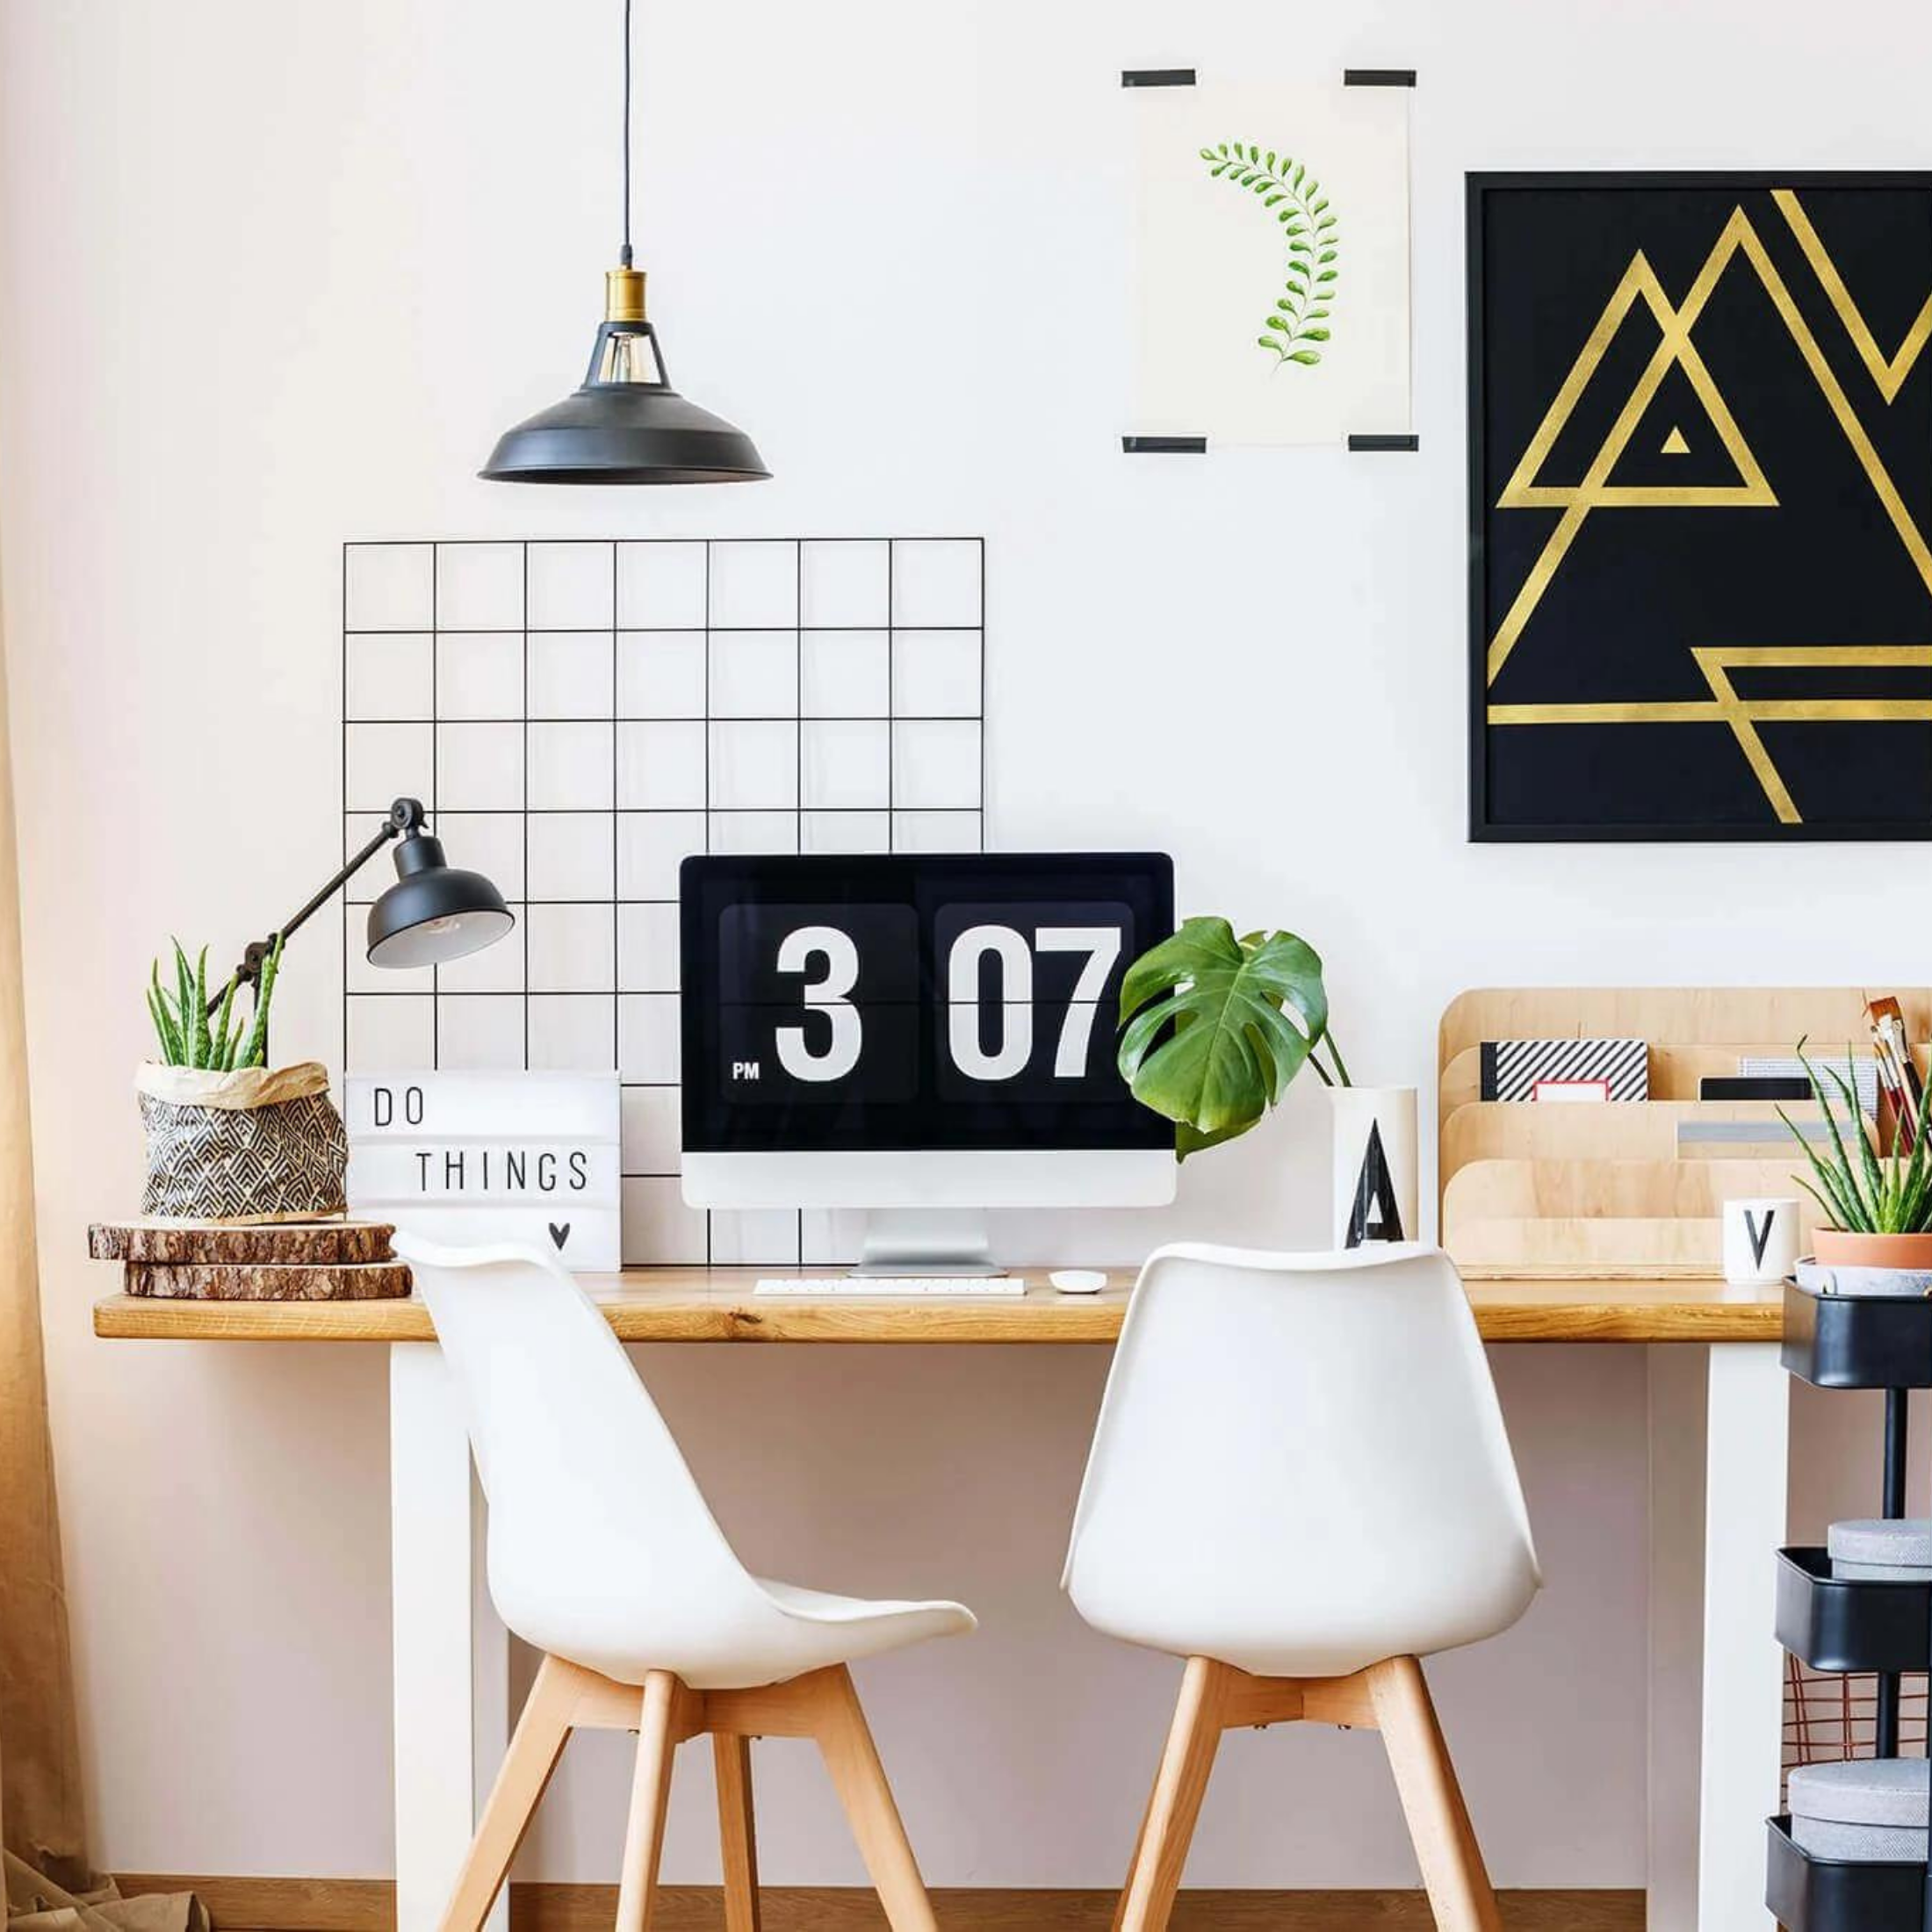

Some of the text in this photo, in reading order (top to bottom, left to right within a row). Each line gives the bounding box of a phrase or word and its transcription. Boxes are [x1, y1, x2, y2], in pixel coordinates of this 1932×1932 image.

[775, 924, 1122, 1082] 3 07
[732, 1062, 760, 1080] PM
[374, 1086, 423, 1127] DO
[415, 1150, 588, 1192] THINGS
[1344, 1117, 1405, 1250] A
[1743, 1209, 1776, 1271] V
